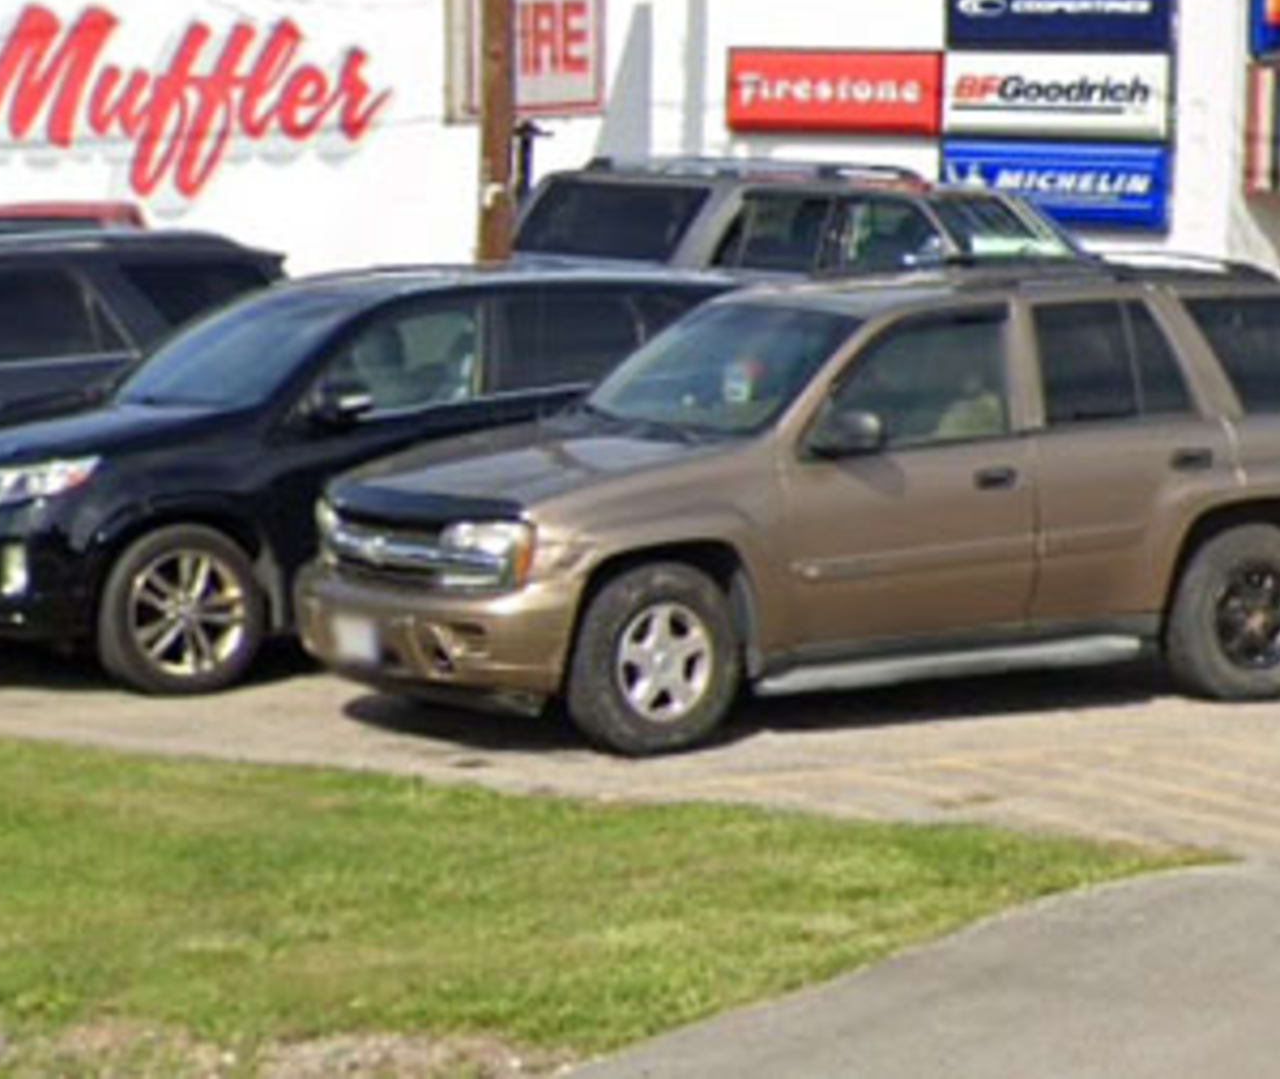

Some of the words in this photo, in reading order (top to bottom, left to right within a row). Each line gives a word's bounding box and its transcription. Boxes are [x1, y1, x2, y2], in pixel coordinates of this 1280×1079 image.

[518, 0, 588, 73] IRE
[736, 71, 922, 108] Firestone
[953, 74, 1150, 104] BFGoodrich
[995, 170, 1153, 194] MICHELIN
